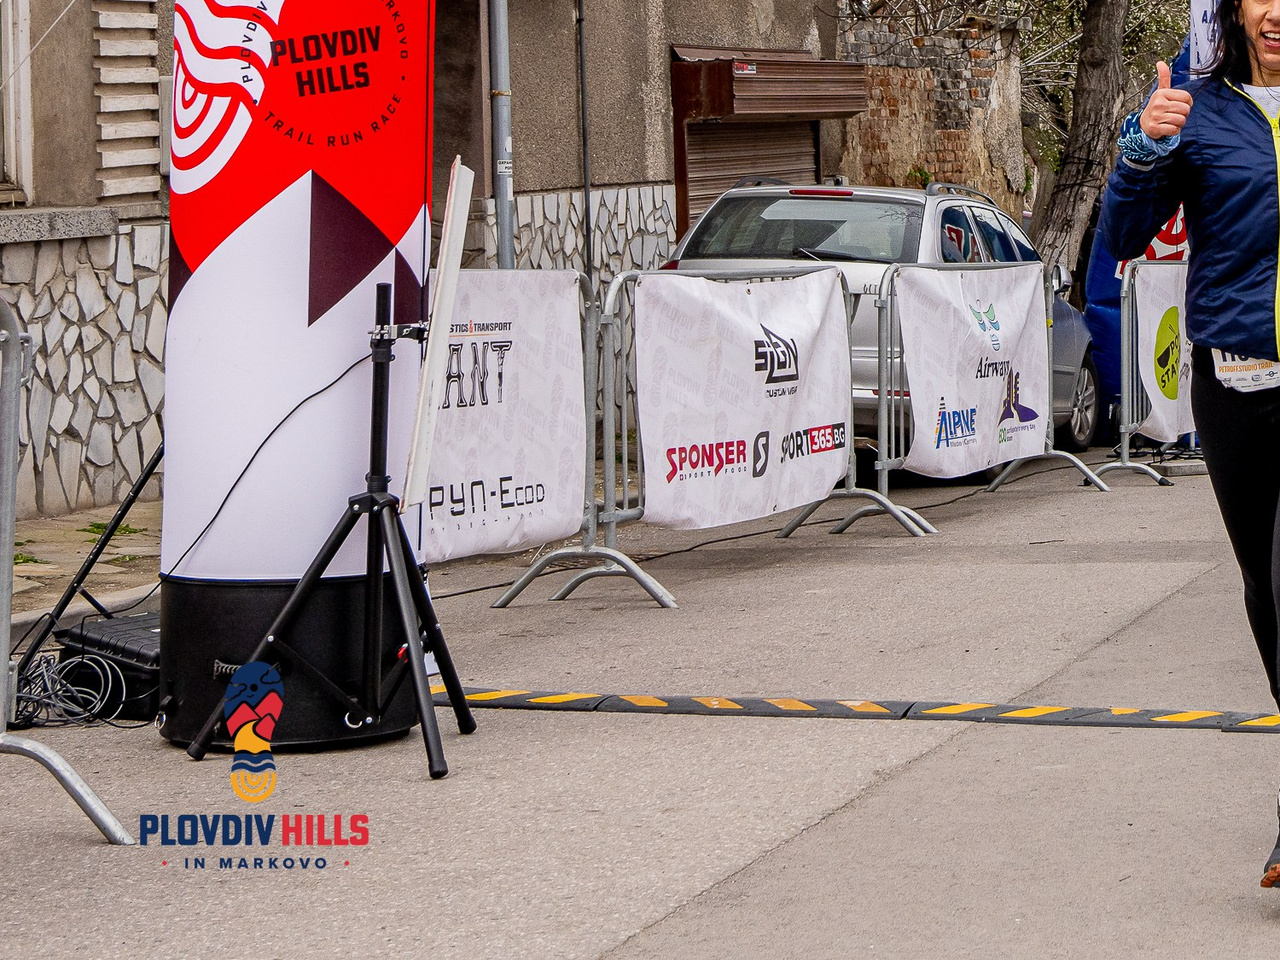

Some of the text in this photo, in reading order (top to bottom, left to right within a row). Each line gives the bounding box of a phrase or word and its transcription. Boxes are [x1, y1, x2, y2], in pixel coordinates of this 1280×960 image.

[270, 25, 381, 67] PLOVDIV
[296, 61, 371, 97] HILLS
[264, 93, 401, 147] TRAIL RUN RACE
[474, 322, 513, 333] TRANSPORT
[438, 340, 513, 410] ANT
[935, 408, 977, 449] ALPINE
[666, 440, 747, 484] SPONSER
